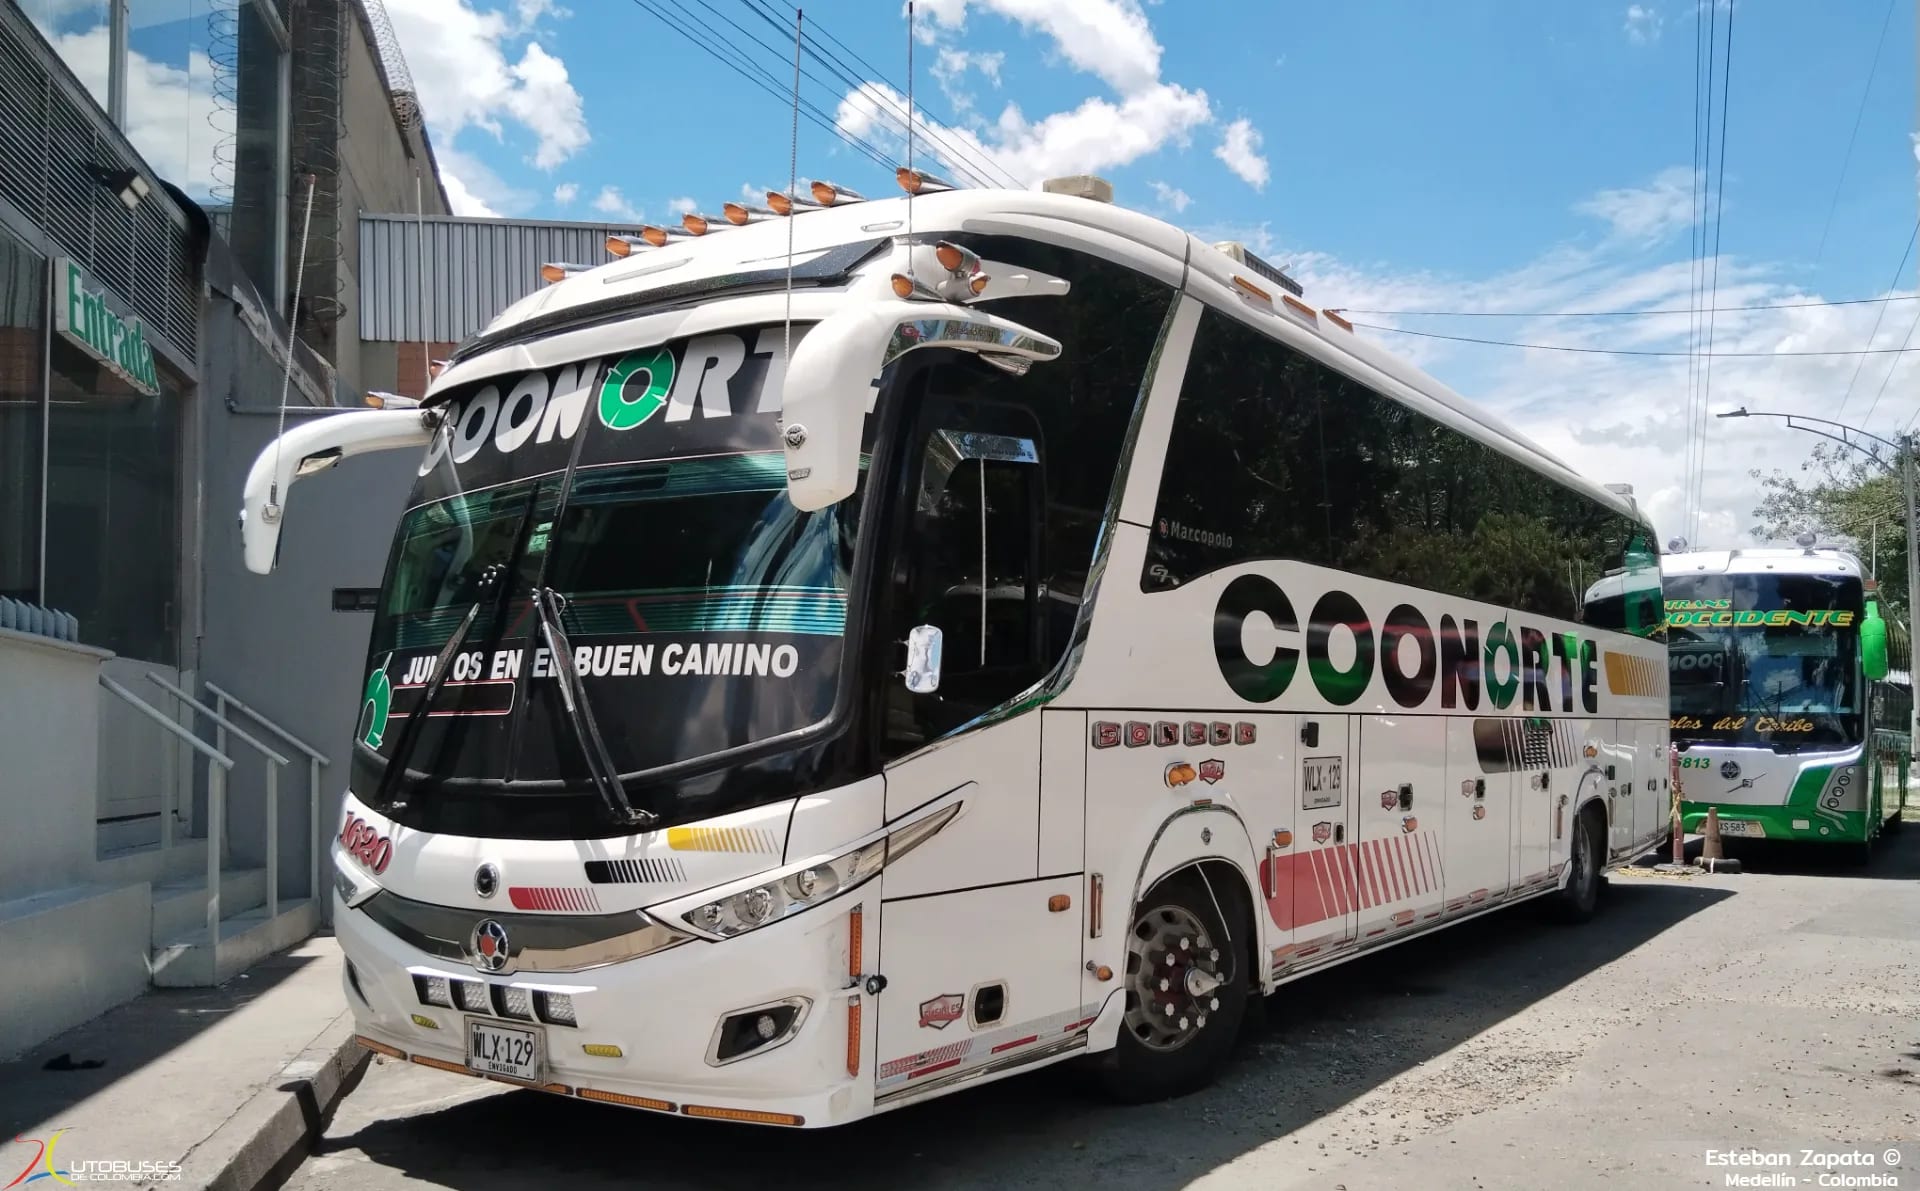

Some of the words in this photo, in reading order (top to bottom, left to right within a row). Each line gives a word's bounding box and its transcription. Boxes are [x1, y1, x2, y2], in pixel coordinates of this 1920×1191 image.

[67, 262, 159, 394] Entrada
[418, 325, 883, 477] COONORT
[1171, 521, 1233, 549] Marcopolo
[1213, 572, 1598, 714] COONORTE
[1665, 610, 1854, 627] OCCIDENTE
[490, 649, 523, 680] EN
[574, 645, 655, 677] BUEN
[661, 643, 799, 678] CAMINO
[1712, 717, 1746, 730] del
[1754, 717, 1814, 733] Caribe
[339, 810, 393, 875] 1620
